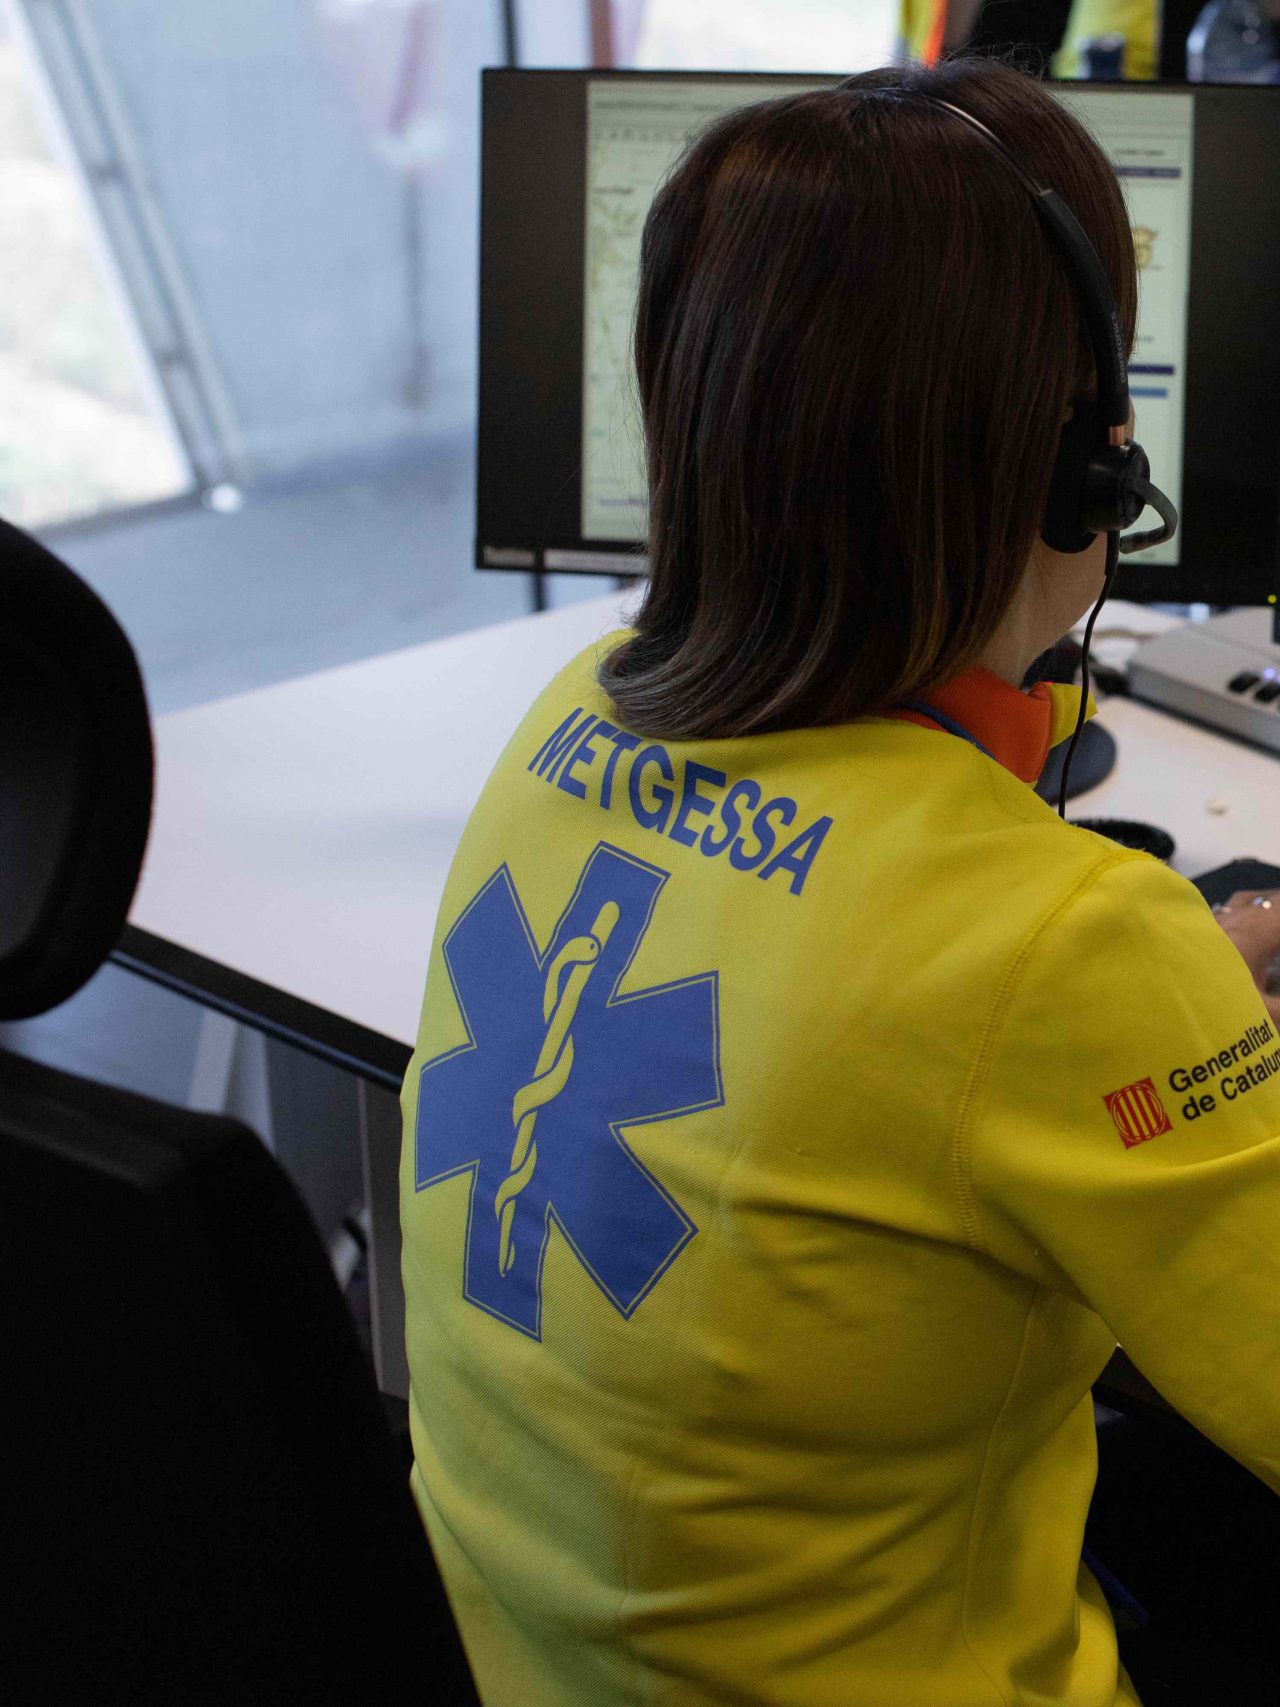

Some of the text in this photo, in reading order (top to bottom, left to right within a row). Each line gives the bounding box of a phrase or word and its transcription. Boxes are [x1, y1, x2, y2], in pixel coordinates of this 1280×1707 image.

[527, 707, 834, 896] METGESSA
[1168, 1018, 1274, 1093] Generalitat
[1181, 1094, 1217, 1121] de
